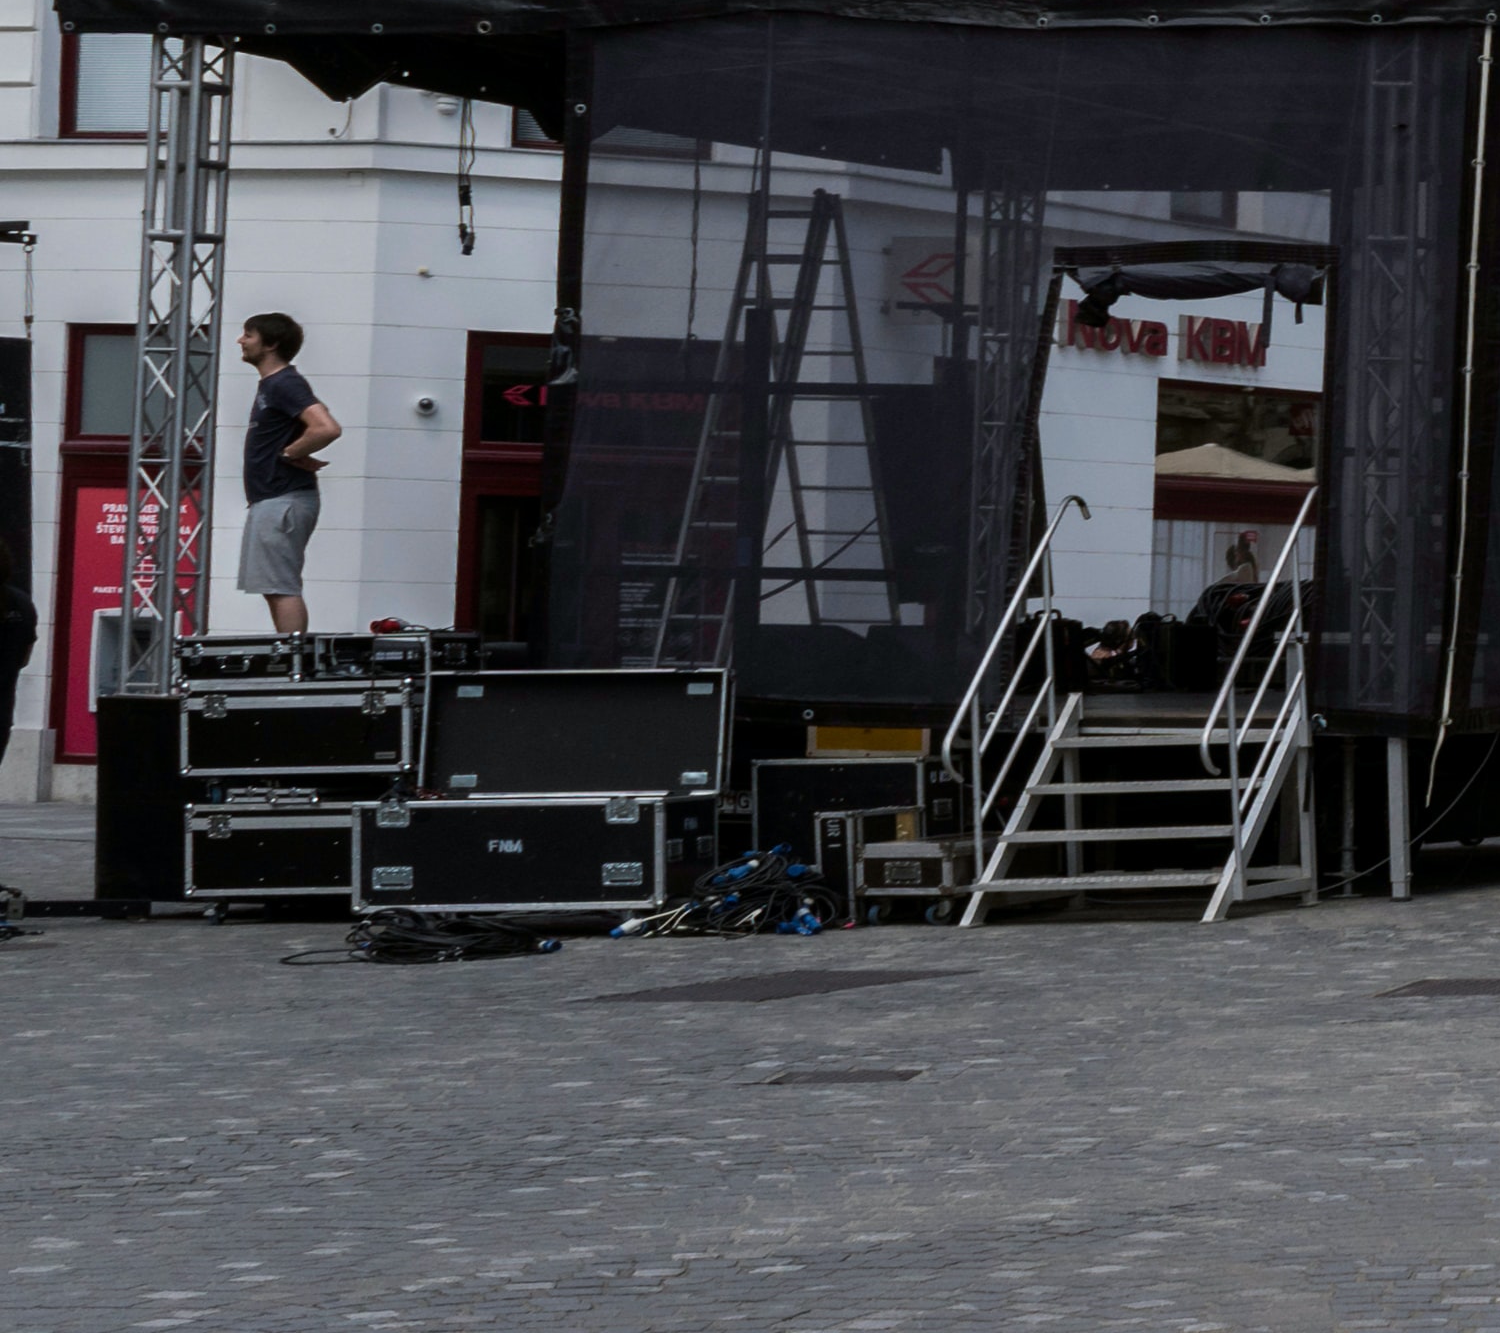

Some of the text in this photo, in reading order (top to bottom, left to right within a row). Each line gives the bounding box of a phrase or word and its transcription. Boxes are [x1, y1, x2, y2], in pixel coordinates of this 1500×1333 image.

[1060, 299, 1267, 367] Nova KBM
[106, 514, 119, 523] ZA
[487, 839, 522, 854] FNM
